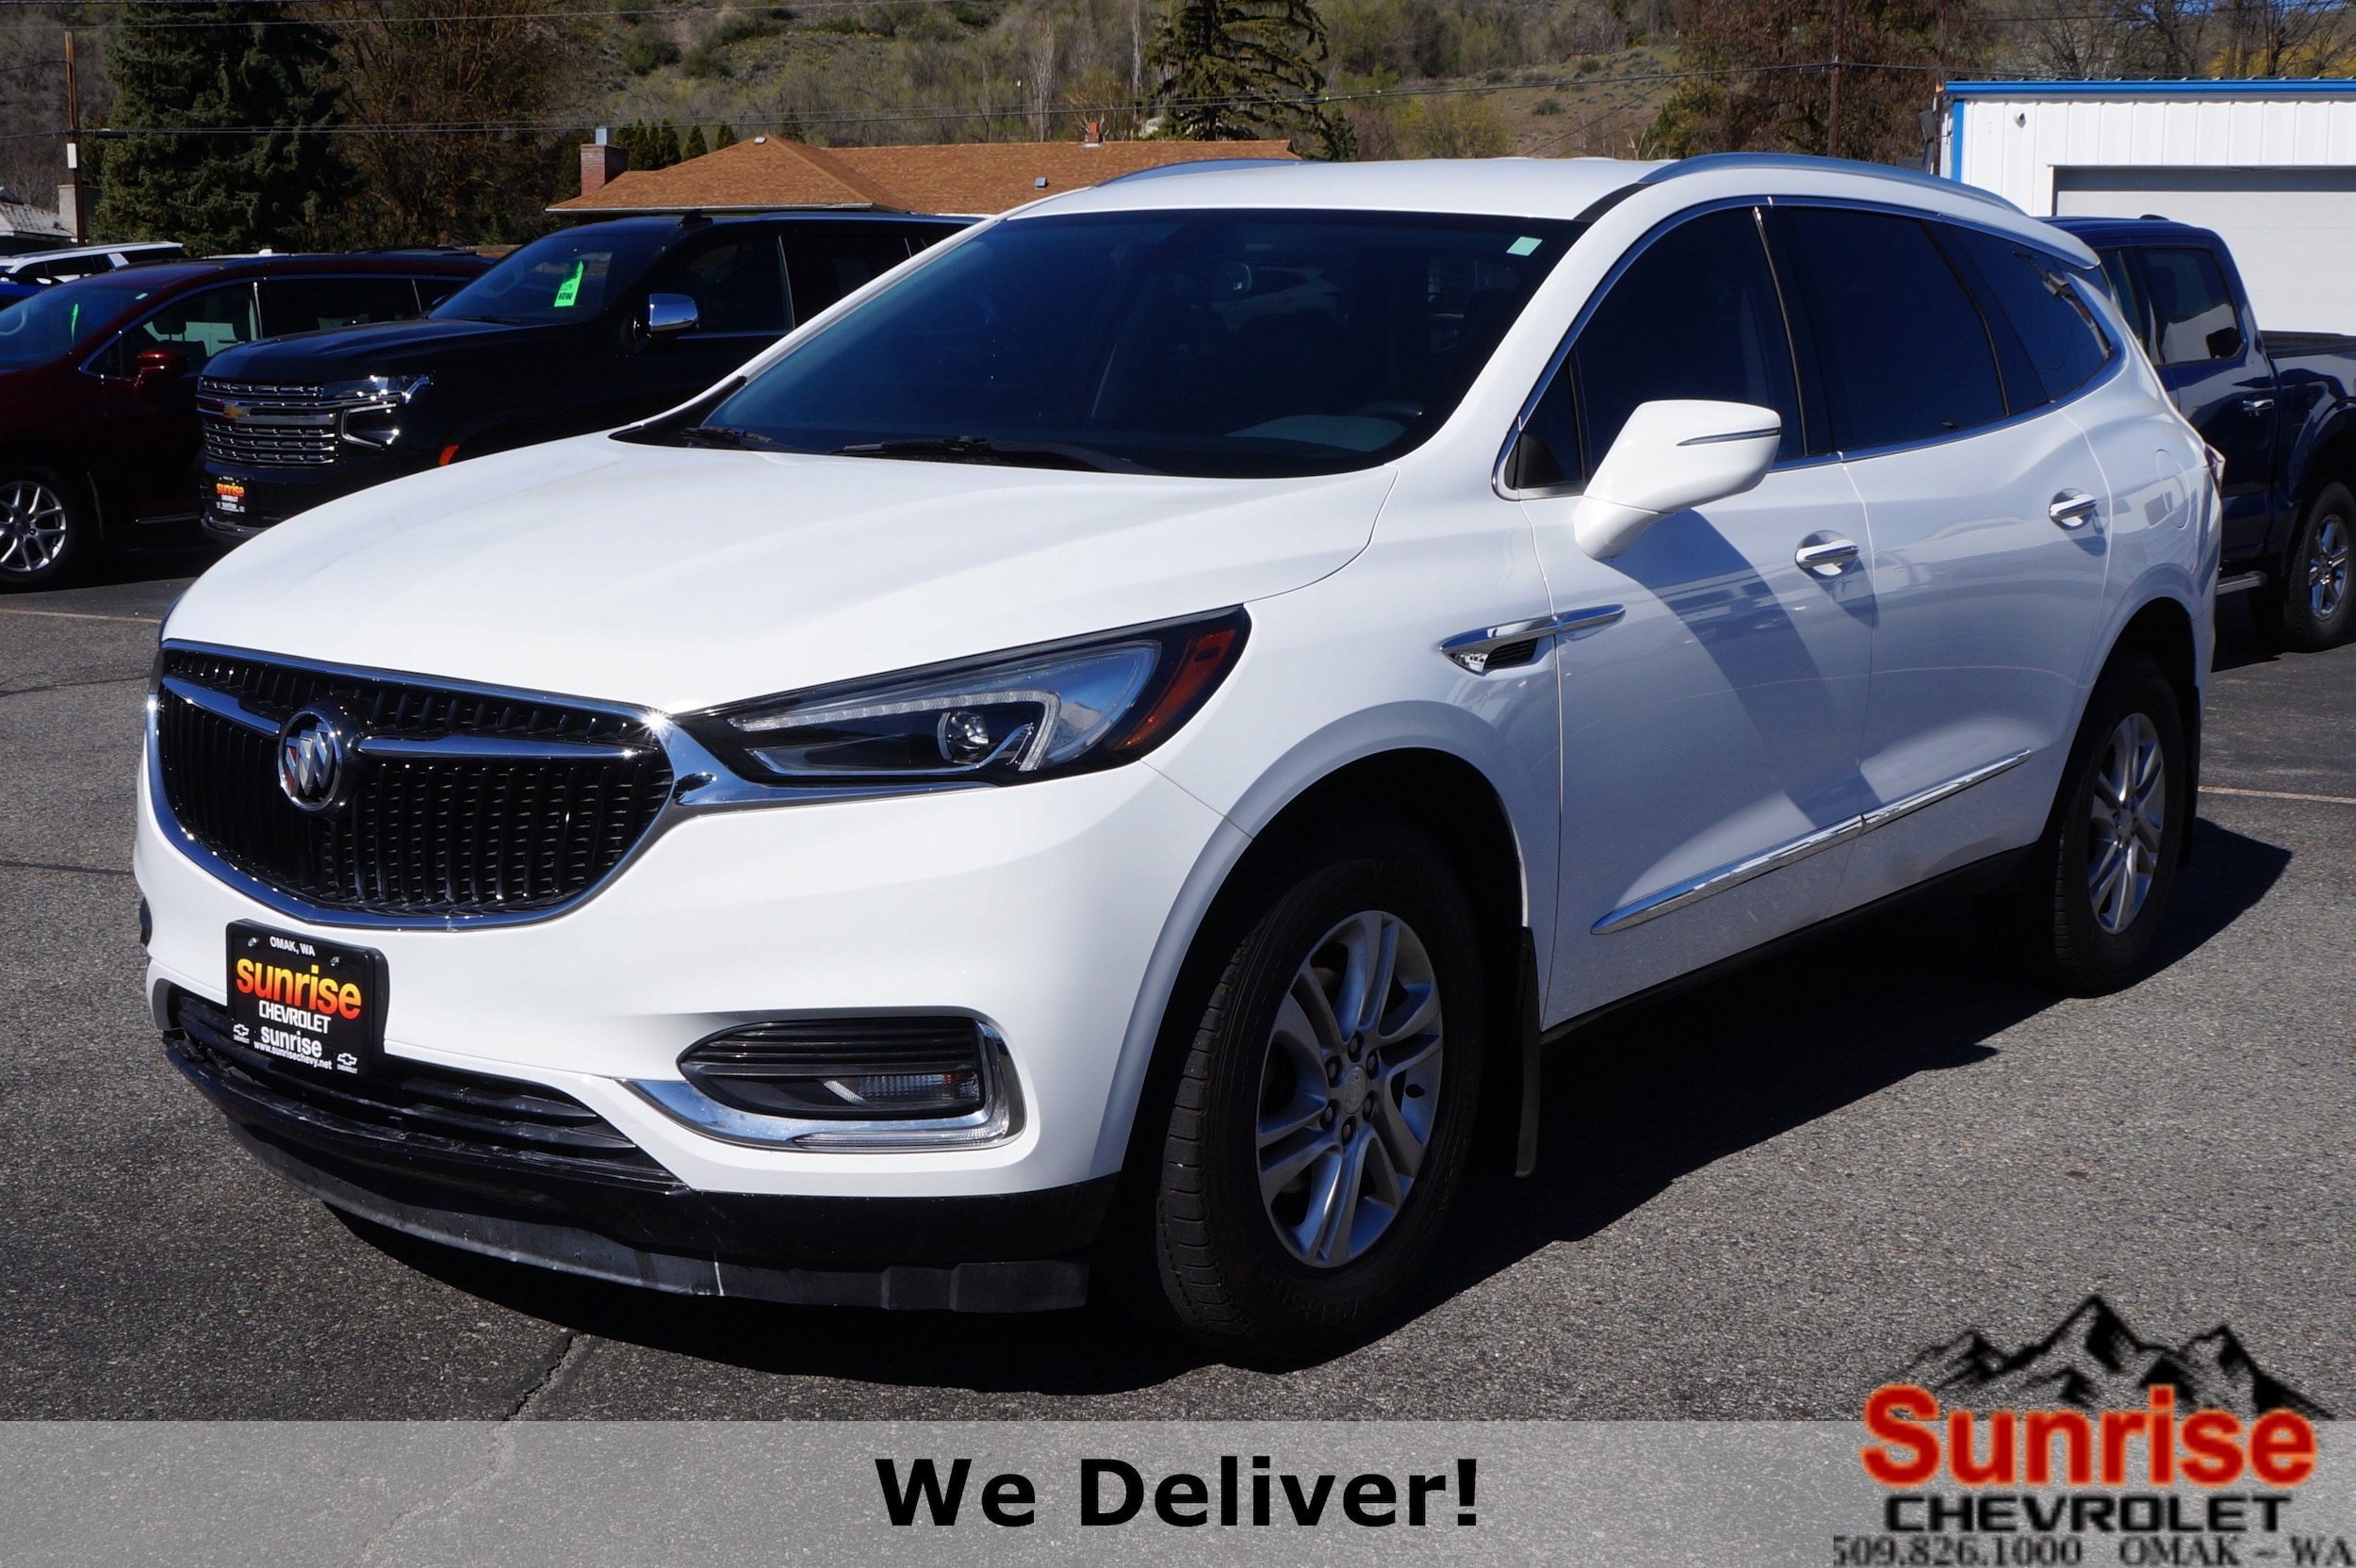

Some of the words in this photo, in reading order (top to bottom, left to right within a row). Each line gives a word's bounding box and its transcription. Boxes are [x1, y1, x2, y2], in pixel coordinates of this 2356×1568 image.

[270, 936, 299, 955] OMAK,
[300, 943, 315, 956] WA
[237, 958, 362, 1020] sunrise
[259, 1000, 332, 1034] CHEVROLET
[254, 1041, 333, 1070] www.sunrisechevy.net
[260, 1026, 322, 1058] sunrise
